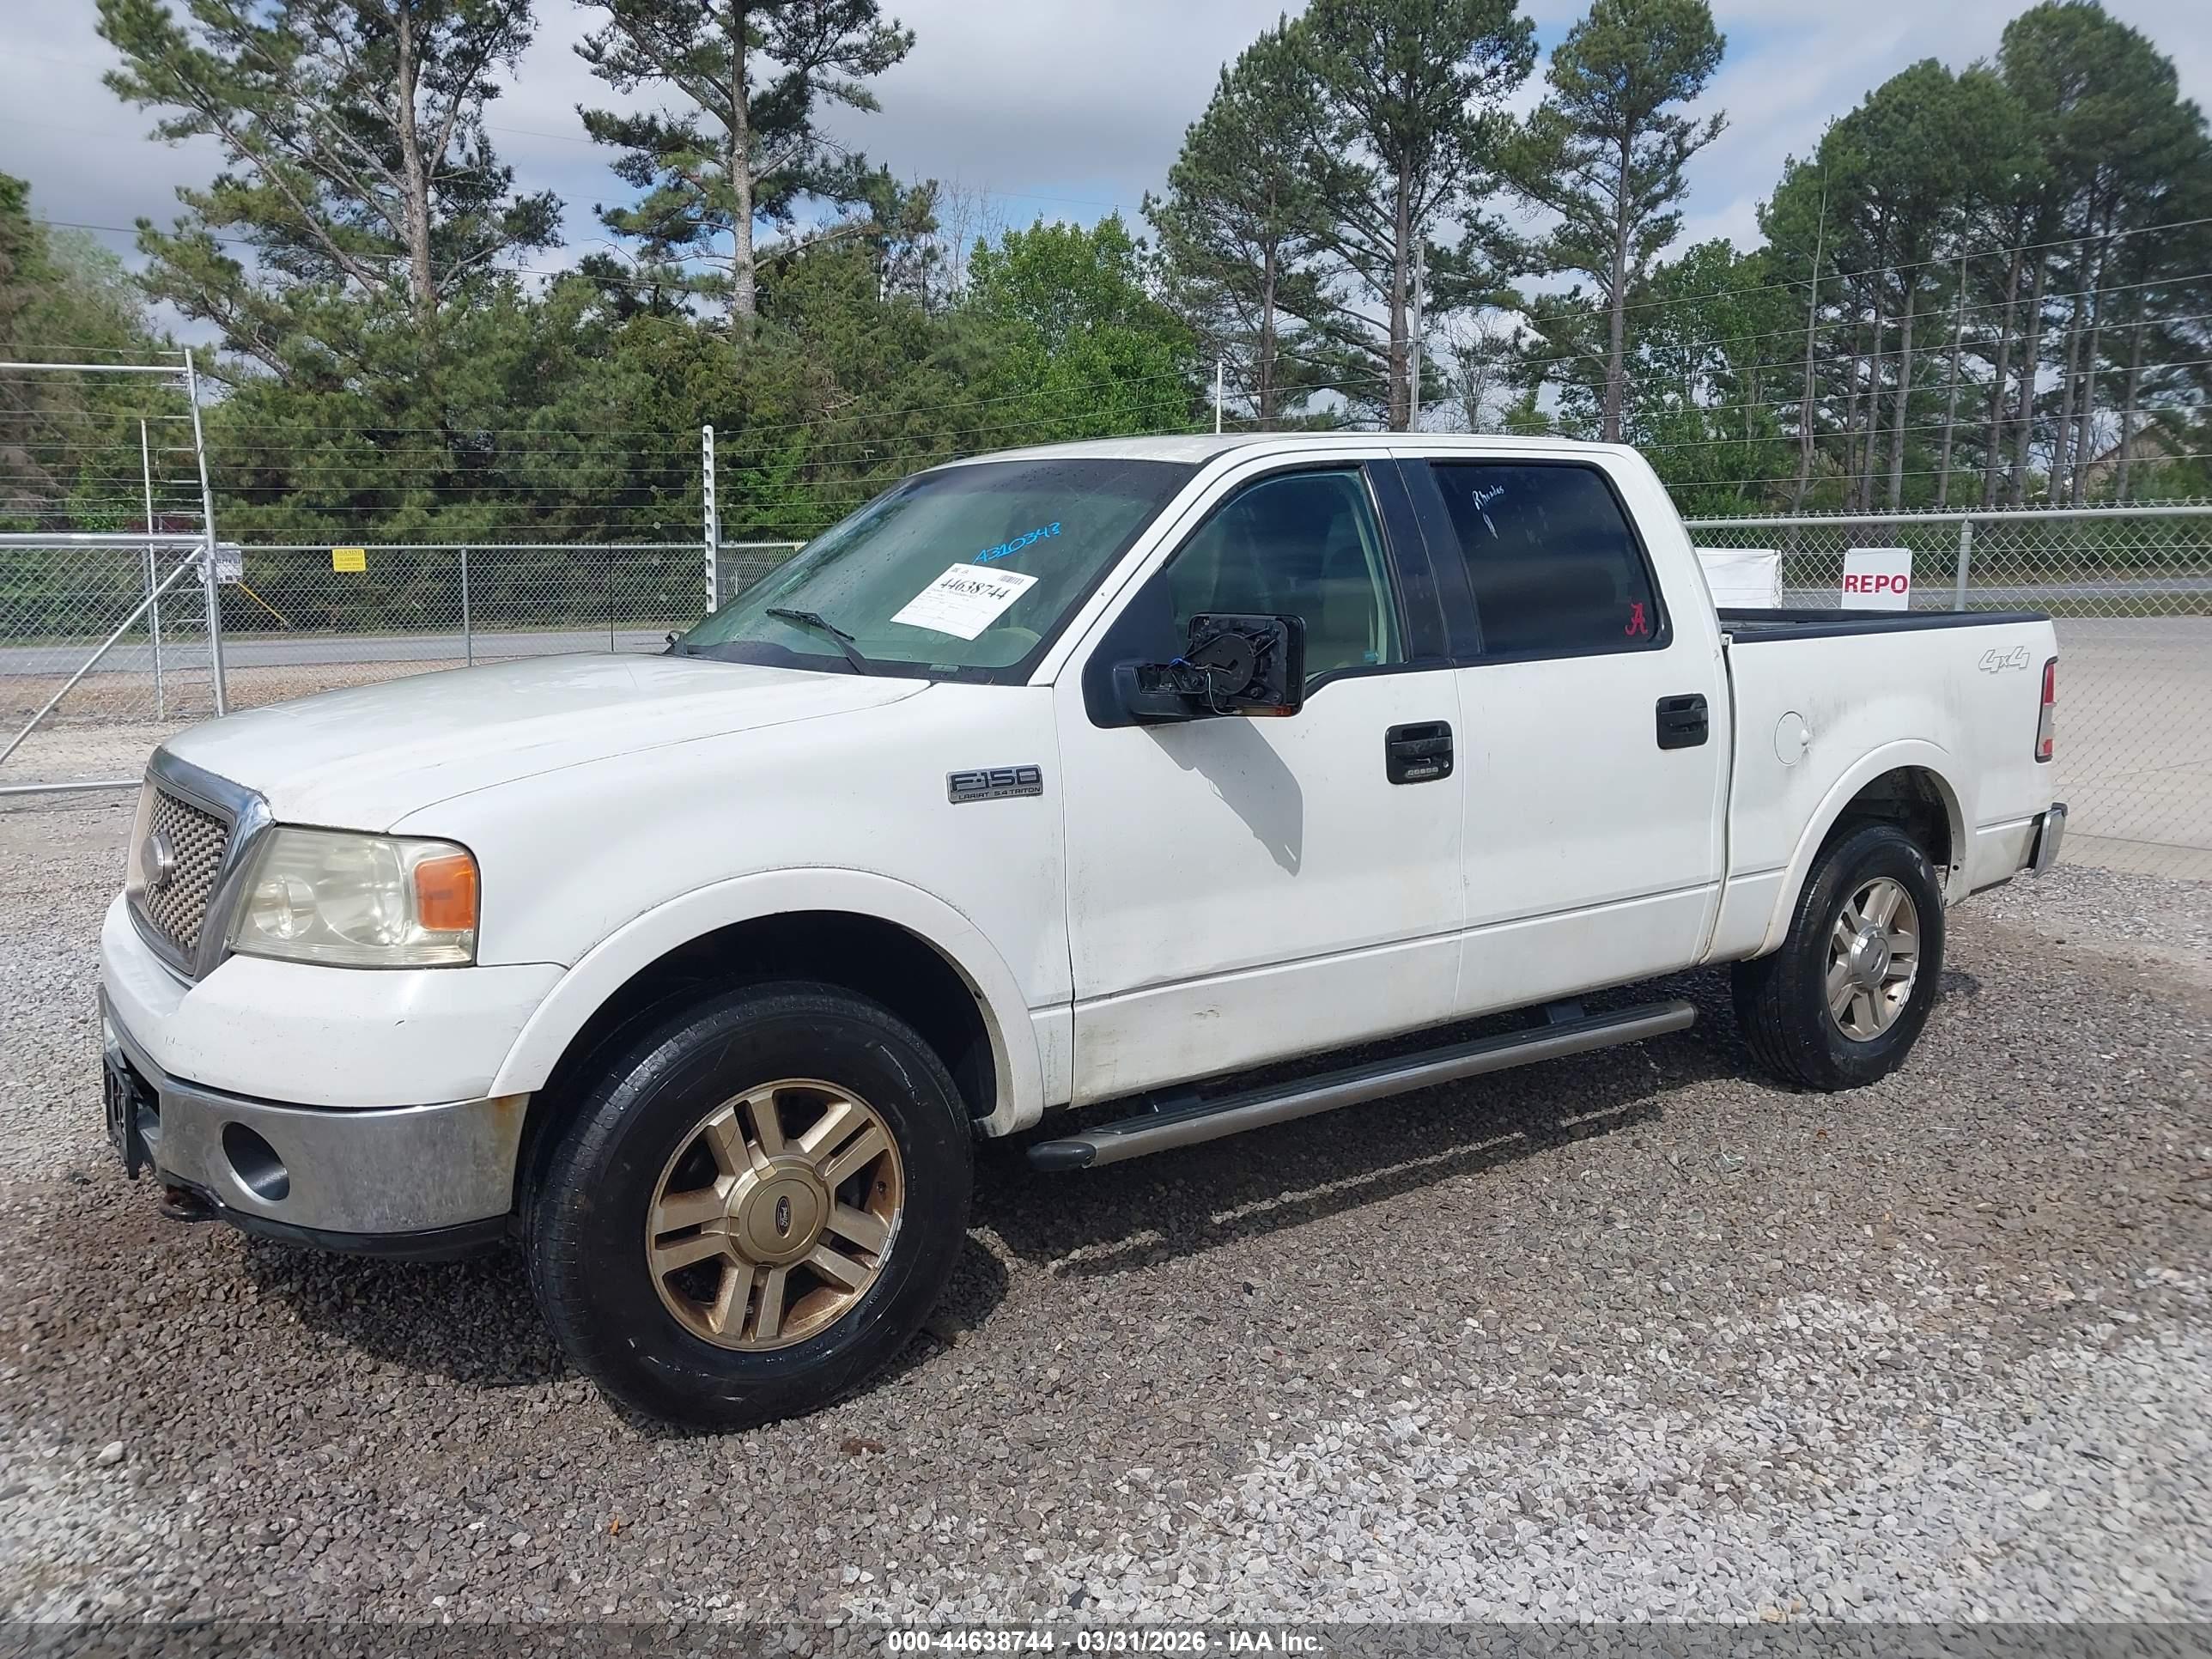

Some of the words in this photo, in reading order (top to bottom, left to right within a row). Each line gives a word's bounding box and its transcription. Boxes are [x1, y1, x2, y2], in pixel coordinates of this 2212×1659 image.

[940, 578, 1012, 600] 44638744
[1844, 574, 1909, 594] REPO
[1978, 646, 2030, 674] 4x4
[958, 792, 989, 800] LARIAT
[1011, 787, 1041, 795] TRITON
